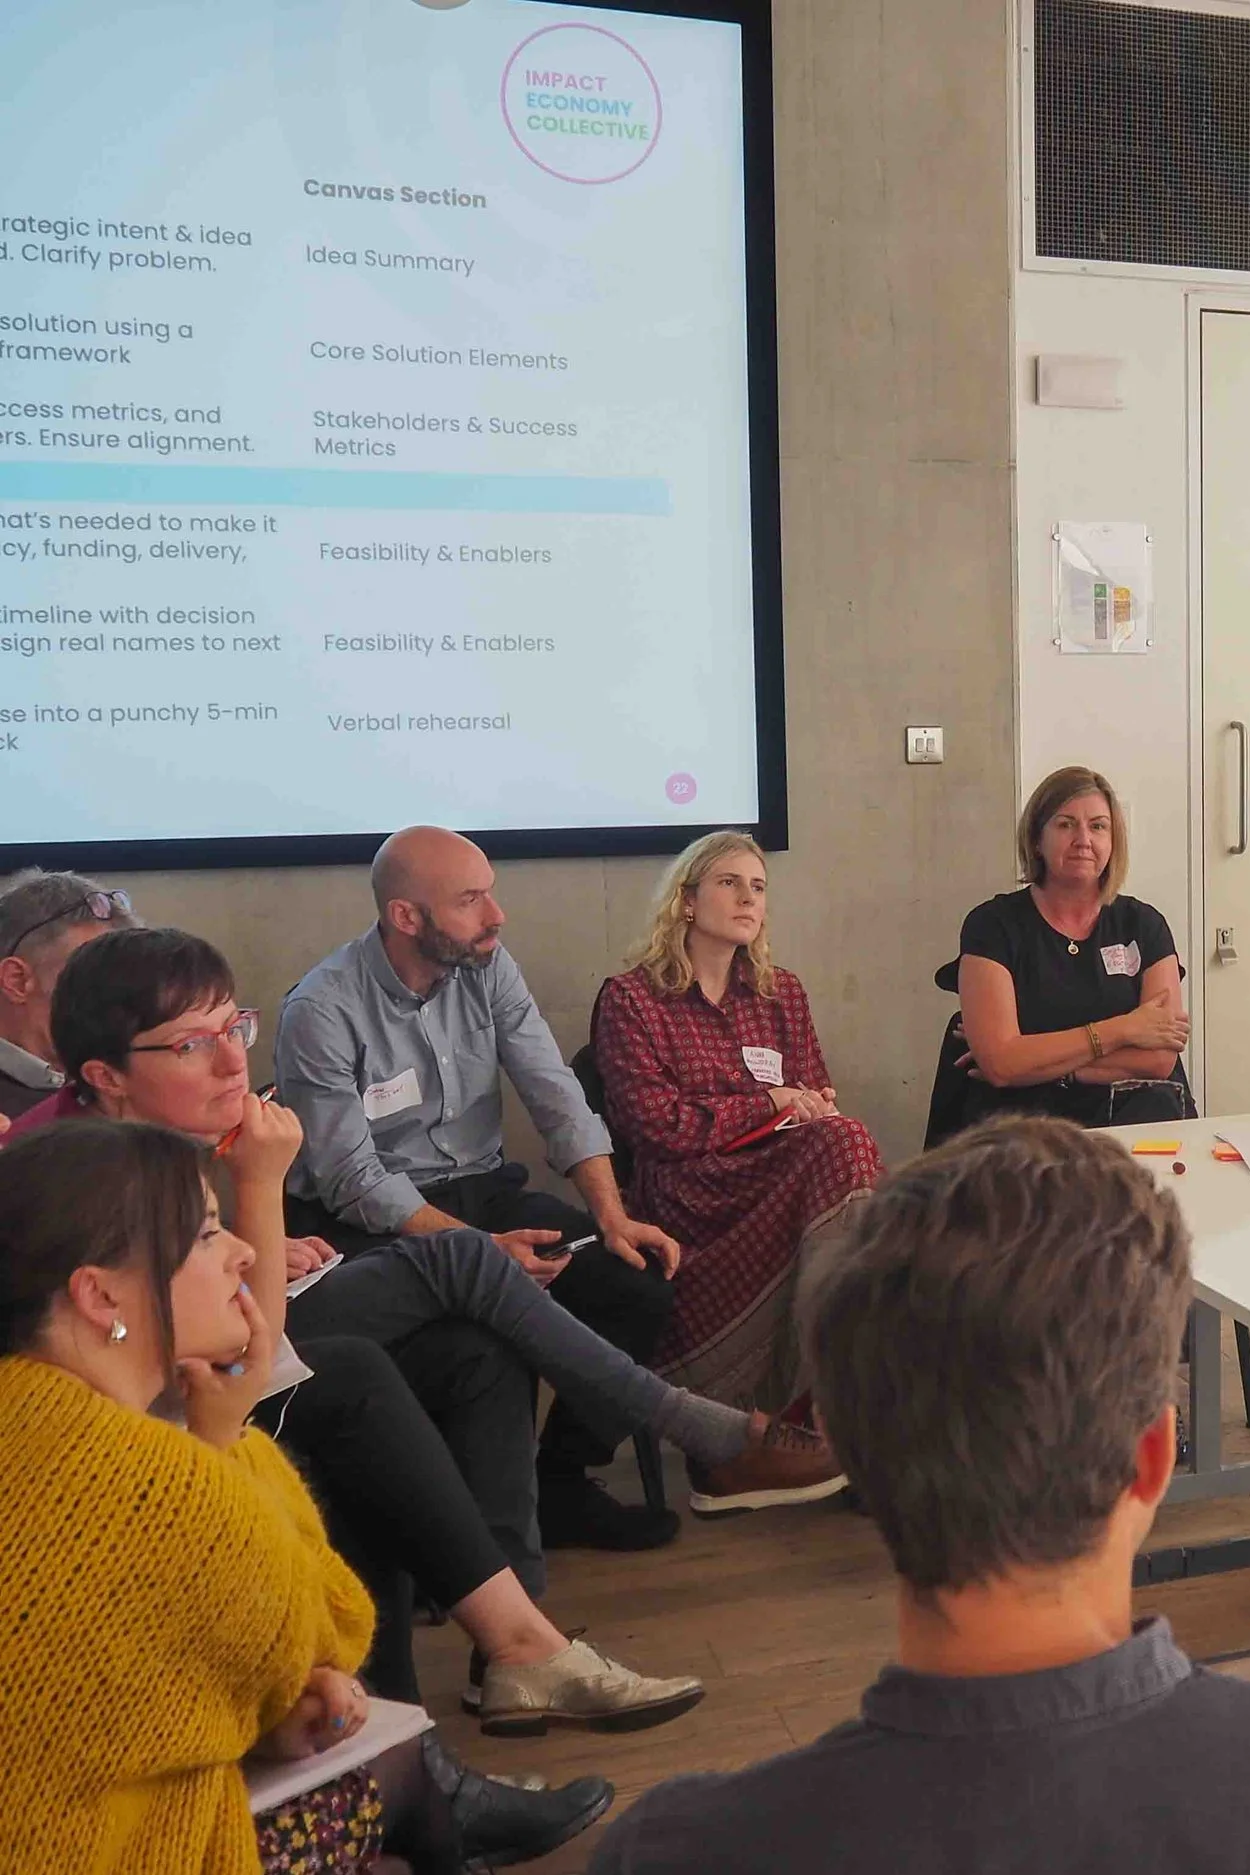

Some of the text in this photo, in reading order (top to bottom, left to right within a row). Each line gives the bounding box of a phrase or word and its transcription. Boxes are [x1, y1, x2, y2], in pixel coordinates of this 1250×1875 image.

[526, 70, 606, 92] IMPACT
[526, 93, 633, 117] ECONOMY
[526, 115, 649, 140] COLLECTIVE
[303, 178, 487, 209] Canvas Section
[1, 215, 253, 247] rategic intent & idea
[20, 243, 102, 271] Clarify
[108, 249, 217, 272] problem.
[306, 244, 476, 277] Idea Summary
[0, 312, 194, 343] solution using a
[0, 339, 131, 364] framework
[309, 340, 569, 371] Core Solution Elements
[71, 401, 168, 425] metrics,
[173, 405, 222, 425] and
[312, 409, 578, 437] Stakeholders & Success
[38, 428, 121, 449] Ensure
[126, 430, 255, 456] alignment.
[314, 436, 397, 457] Metrics
[58, 511, 152, 531] needed
[158, 513, 183, 532] to
[189, 514, 257, 533] make
[263, 514, 278, 533] it
[1, 537, 247, 565] cy, funding, delivery,
[319, 542, 553, 567] Feasibility & Enablers
[0, 604, 256, 625] imeline with decision
[0, 632, 282, 658] sign real names to next
[323, 632, 556, 658] Feasibility & Enablers
[0, 708, 27, 724] se
[34, 703, 80, 723] into
[87, 707, 103, 723] a
[109, 703, 200, 728] punchy
[327, 712, 511, 732] Verbal rehearsal
[671, 781, 690, 795] 22
